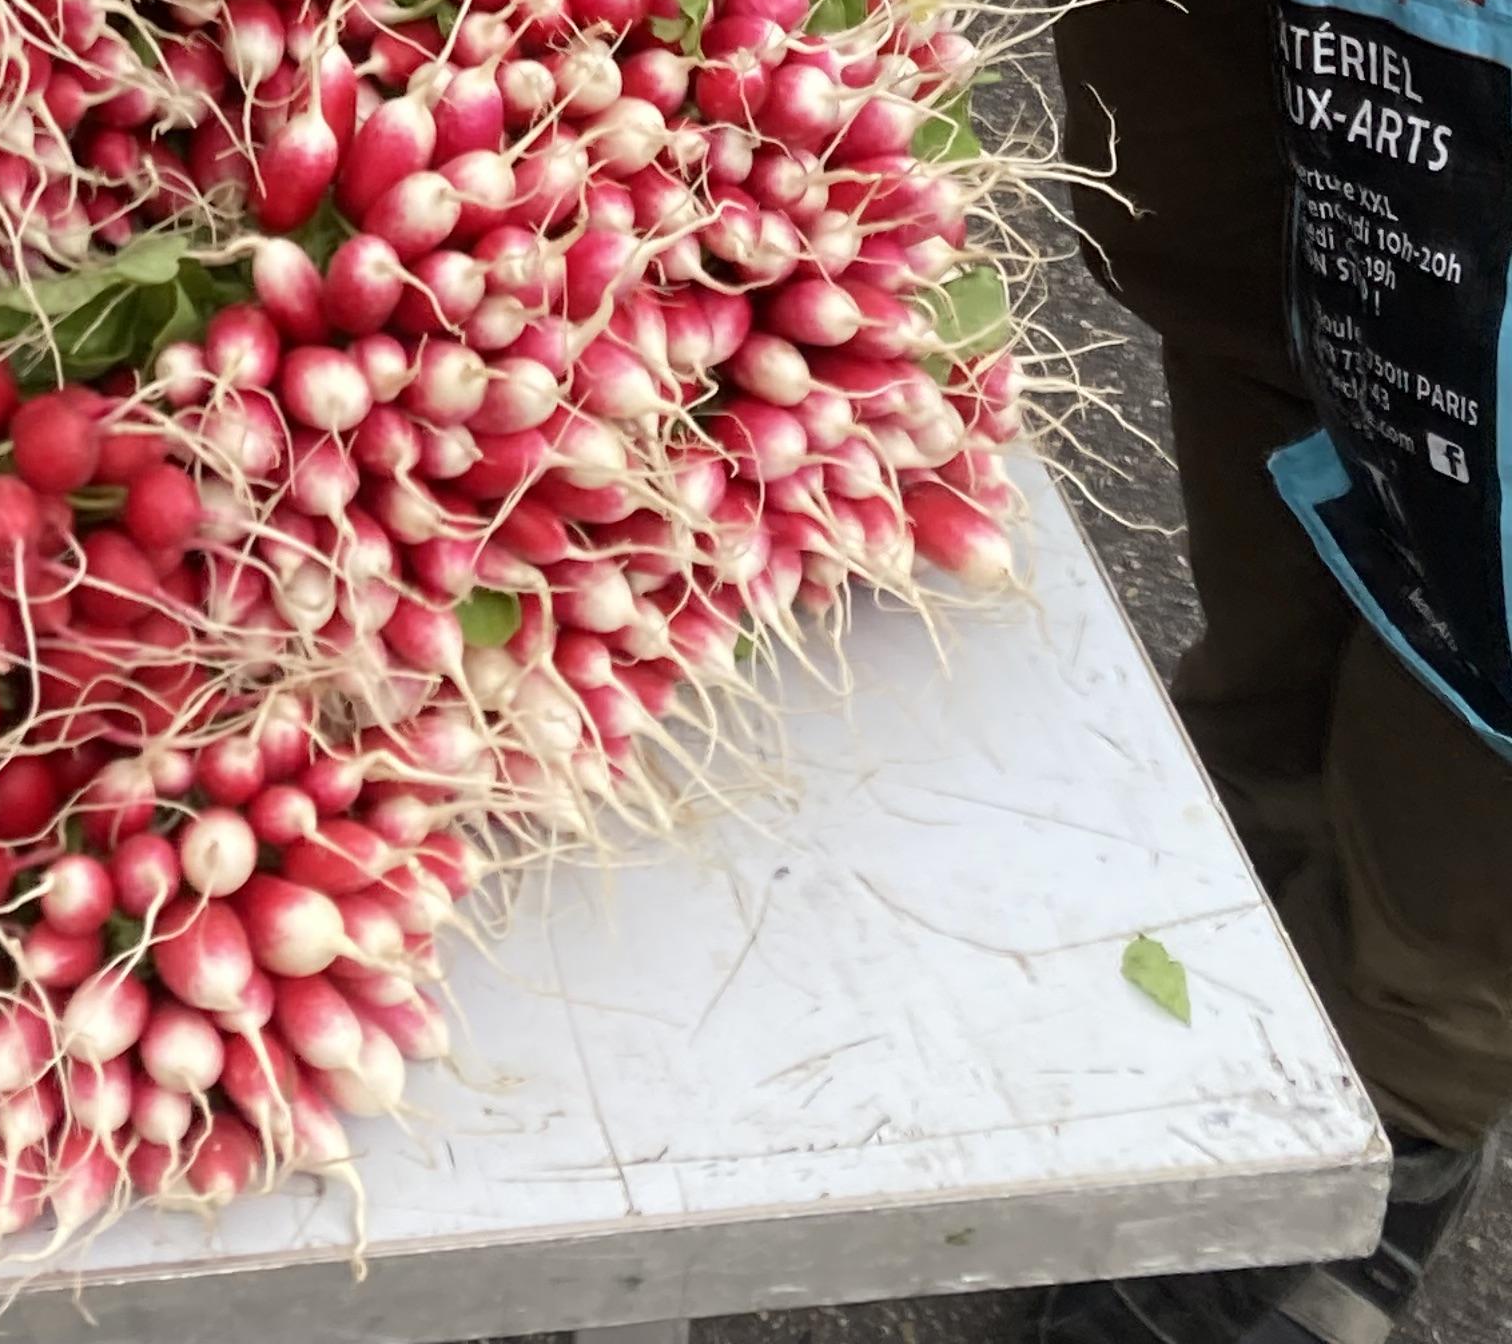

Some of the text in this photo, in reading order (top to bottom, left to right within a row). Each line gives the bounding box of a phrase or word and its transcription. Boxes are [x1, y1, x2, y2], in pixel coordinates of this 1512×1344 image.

[1360, 185, 1399, 222] XXL
[1376, 227, 1462, 285] 10h-20h
[1415, 373, 1480, 427] PARIS
